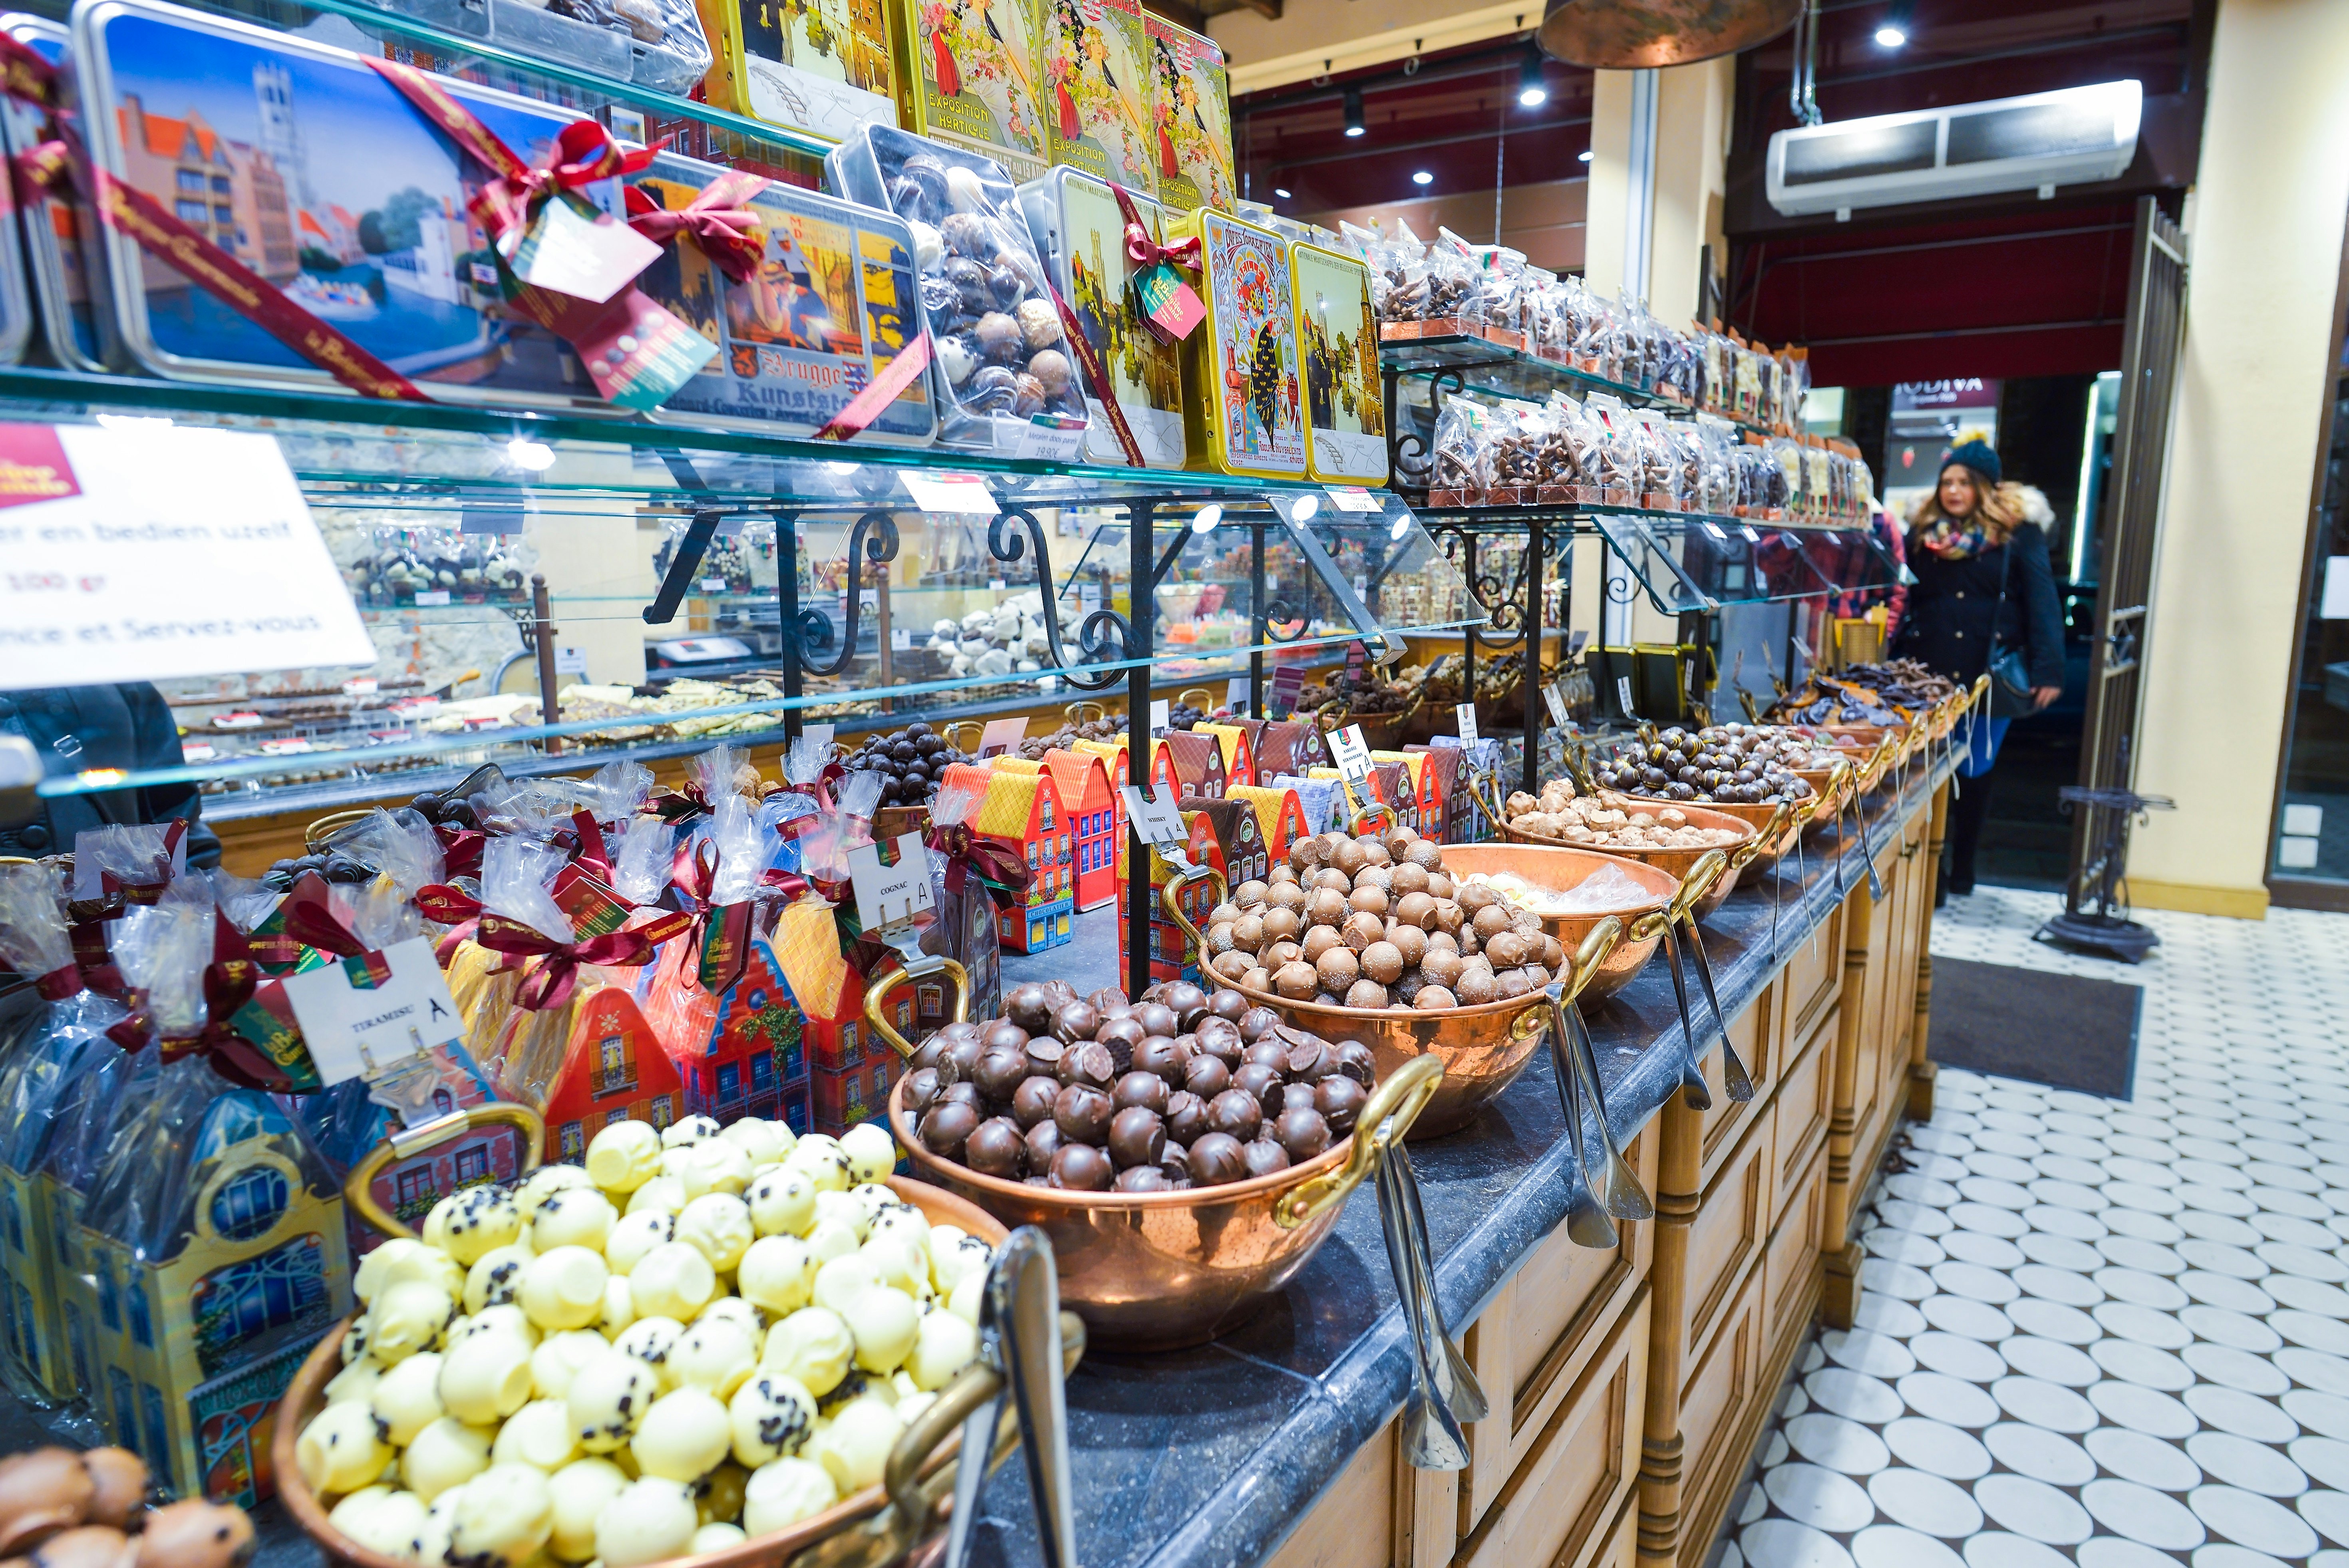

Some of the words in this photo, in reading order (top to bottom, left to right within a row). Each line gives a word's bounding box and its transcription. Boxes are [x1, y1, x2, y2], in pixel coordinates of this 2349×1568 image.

[1191, 37, 1224, 68] BRUGES
[929, 93, 989, 123] EXPOSITION
[938, 113, 991, 141] HORTICOLE
[1053, 138, 1105, 163] EXPOSITION
[1065, 177, 1087, 193] NATIONALE
[1158, 177, 1198, 199] EXPOSITION
[1163, 193, 1197, 212] HORTICOLE
[1297, 250, 1313, 262] NATIONALE
[1151, 279, 1182, 323] Gourmande
[1156, 276, 1162, 286] la
[1160, 280, 1184, 316] Belgique
[1151, 293, 1160, 306] Finest
[1161, 306, 1172, 322] Belgian
[1074, 334, 1098, 379] Gourmande
[759, 350, 841, 391] Brugge
[1109, 404, 1127, 438] Belgique
[1028, 431, 1049, 441] Metalen
[1049, 434, 1062, 443] doos
[1258, 441, 1275, 453] ADOLPHE
[1035, 446, 1060, 459] 19.90€
[1230, 452, 1253, 461] IMPORTATION
[1342, 752, 1363, 763] STRAWBERRY
[1364, 755, 1371, 771] A
[1175, 823, 1182, 832] A
[880, 881, 908, 895] COGNAC
[919, 882, 928, 904] A
[1030, 901, 1069, 918] CHOCOLATIER
[645, 916, 692, 941] Gourmande
[351, 1004, 415, 1033] TIRAMISU
[429, 998, 450, 1023] A
